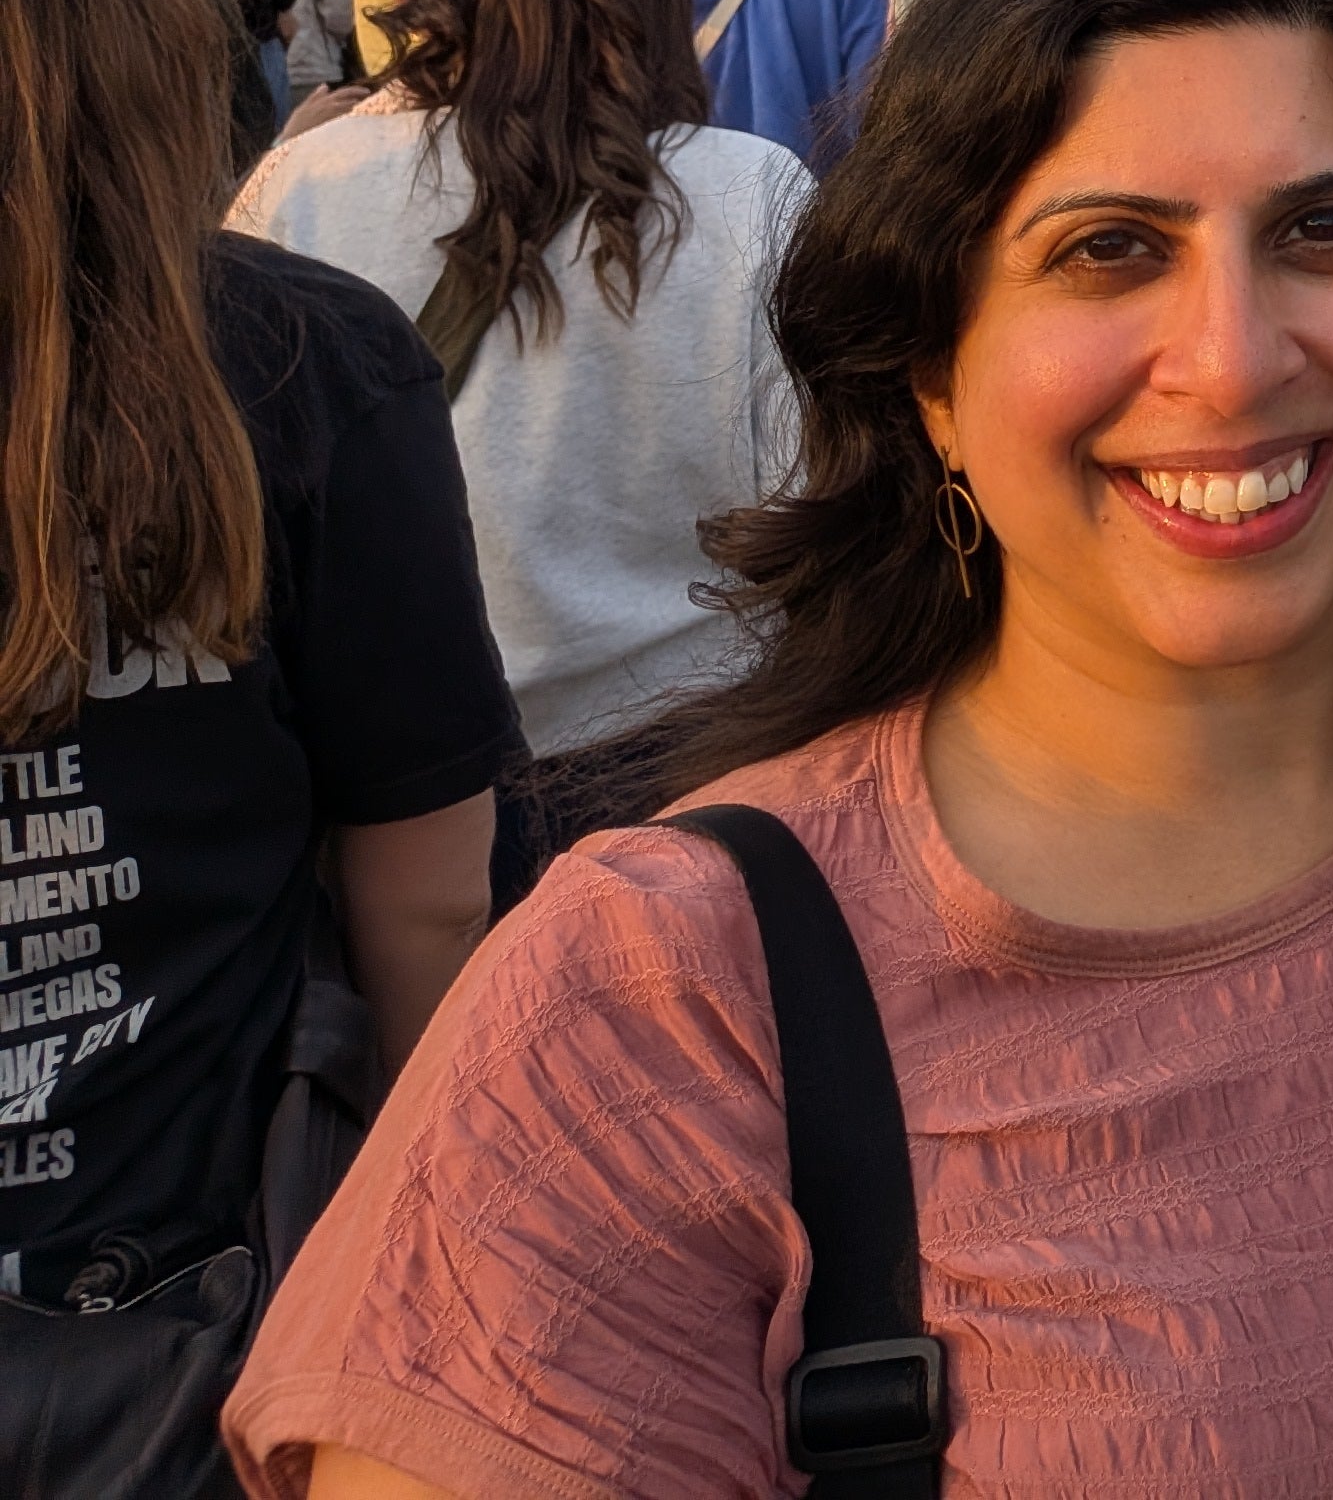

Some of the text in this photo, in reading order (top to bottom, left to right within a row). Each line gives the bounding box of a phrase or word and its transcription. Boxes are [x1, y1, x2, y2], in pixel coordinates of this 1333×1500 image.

[0, 805, 104, 865] LAND
[0, 857, 141, 925] MENTO
[0, 923, 101, 982] LAND
[0, 1128, 75, 1188] LES
